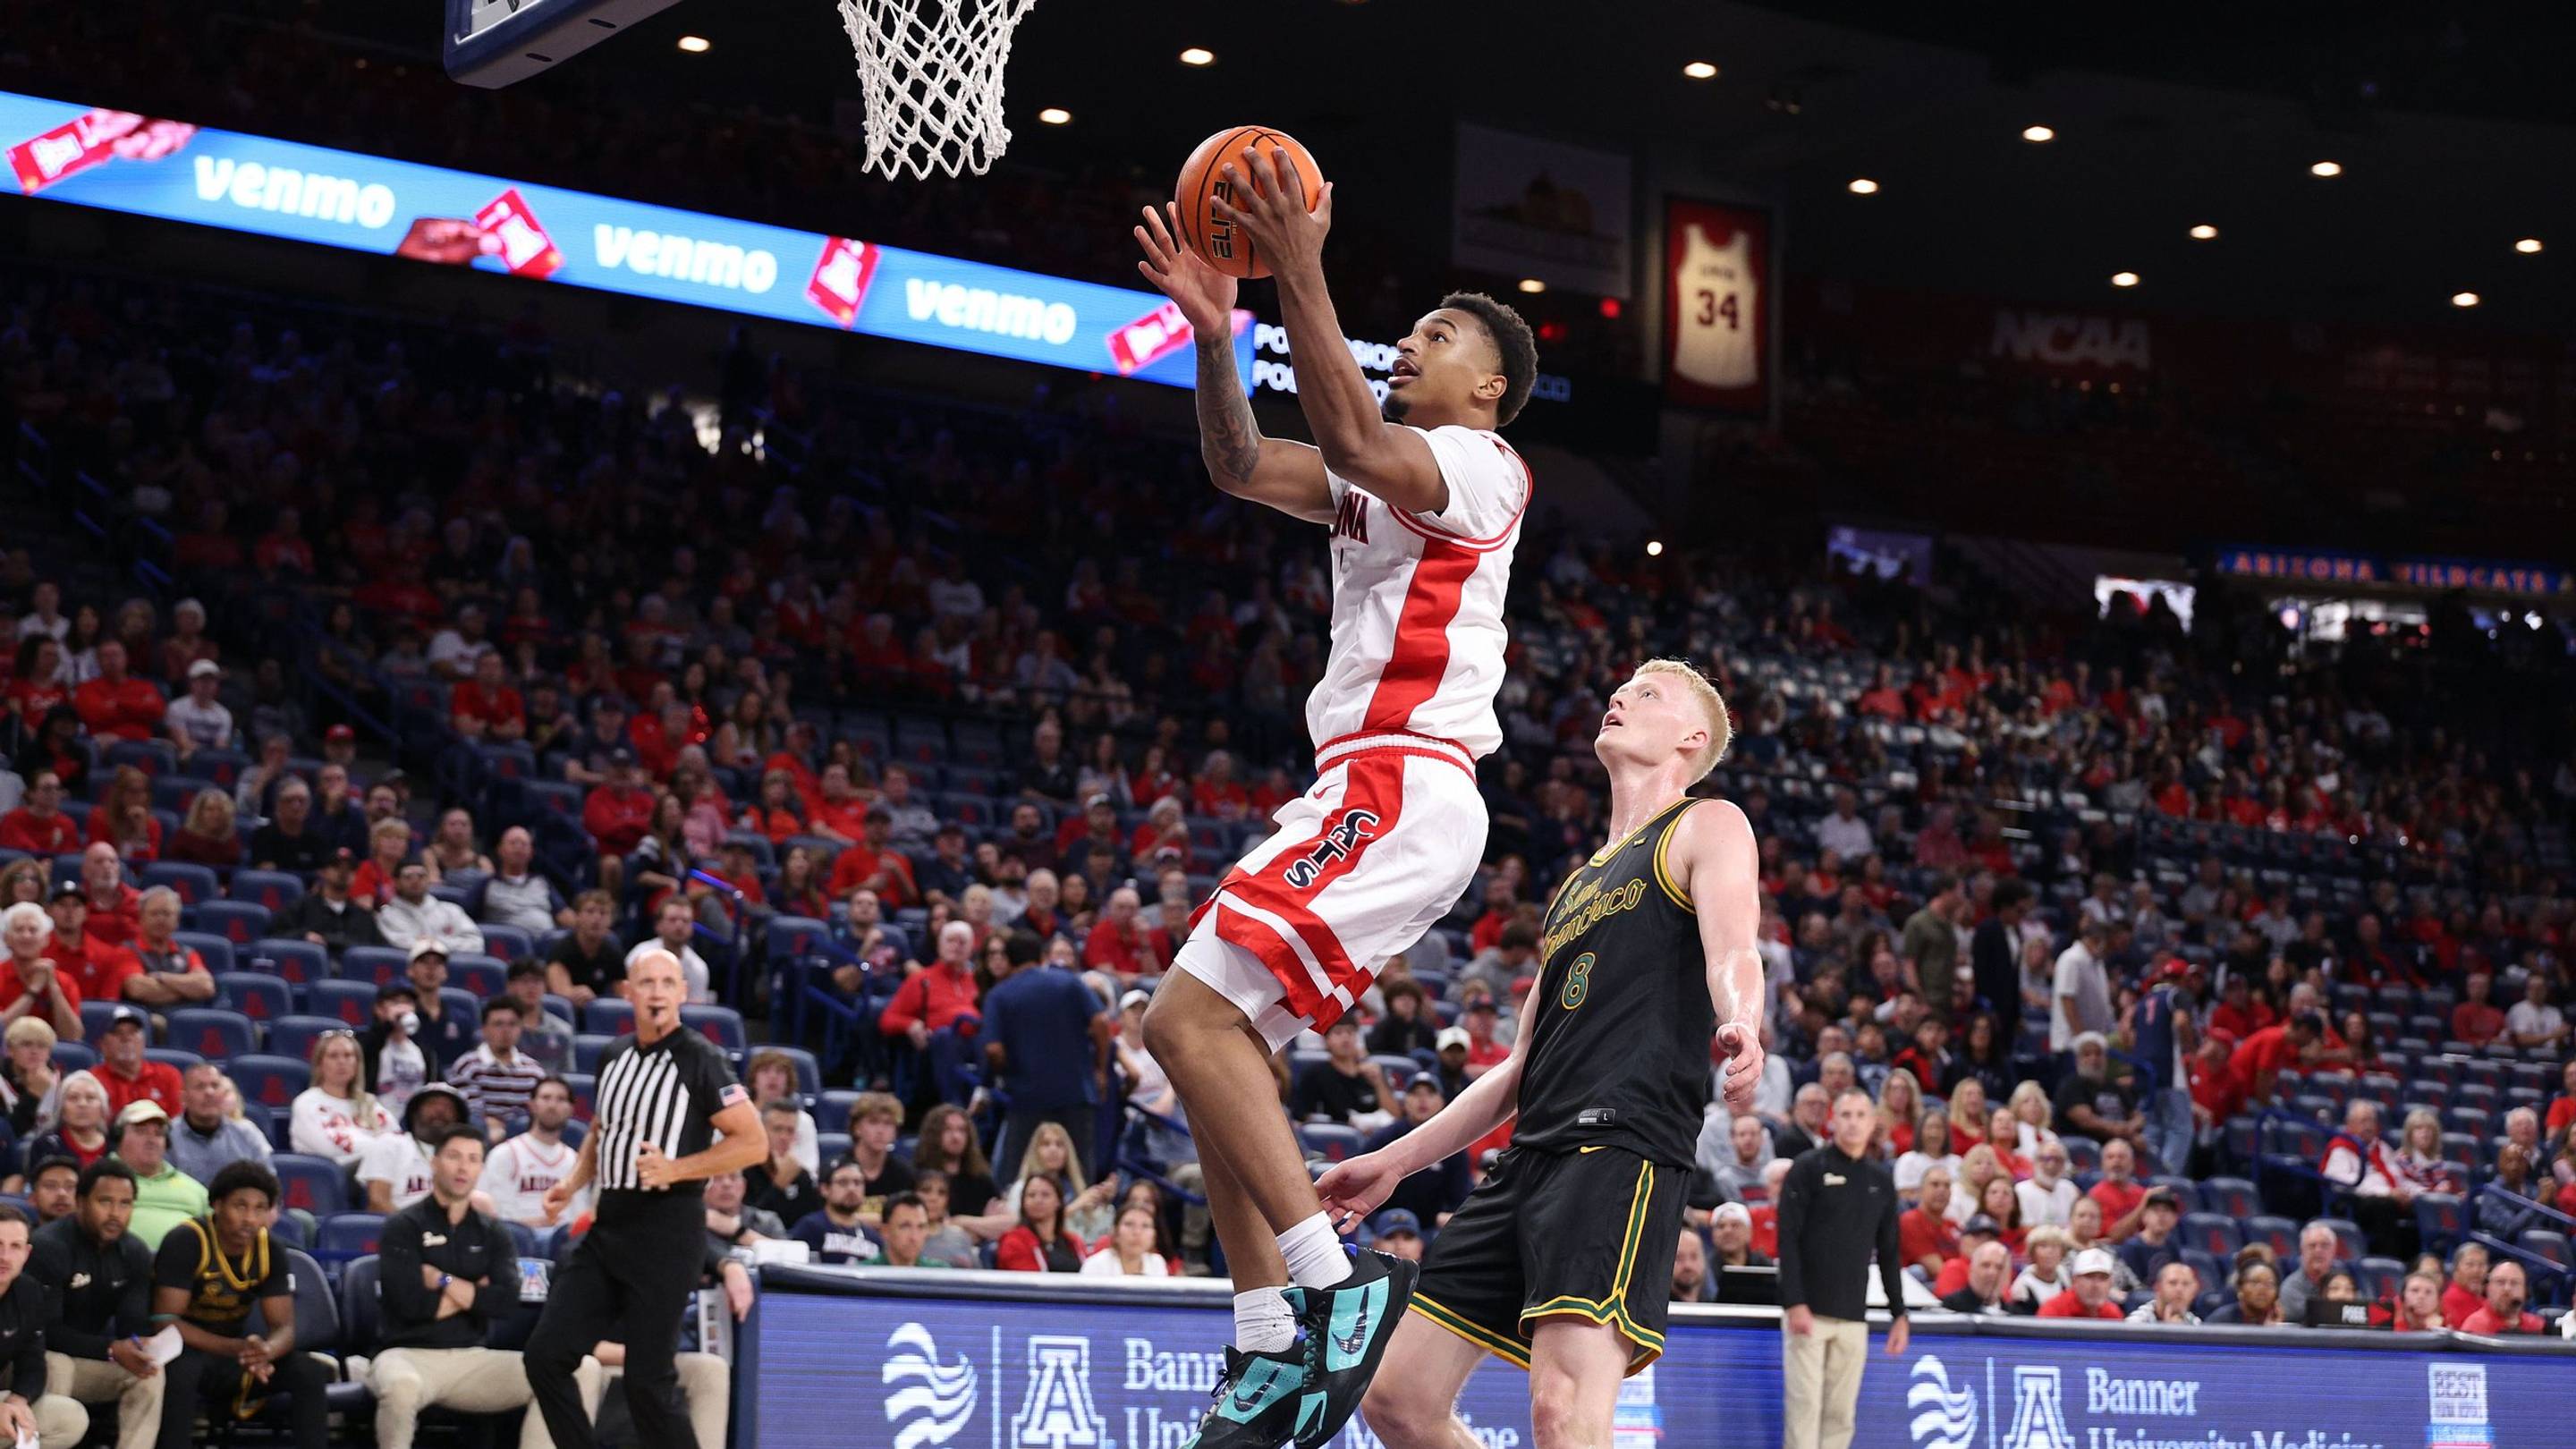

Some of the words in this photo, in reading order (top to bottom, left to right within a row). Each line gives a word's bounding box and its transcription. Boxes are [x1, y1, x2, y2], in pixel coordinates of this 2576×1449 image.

[194, 156, 395, 229] venmo
[594, 223, 777, 294] venmo
[905, 277, 1077, 345] venmo
[1697, 287, 1739, 330] 34
[1990, 308, 2151, 372] NCAA
[2233, 551, 2376, 583] ARIZONA
[2390, 562, 2546, 594] WILDCATS
[1556, 877, 1602, 922] San
[1562, 952, 1596, 1010] 8
[1603, 1112, 1608, 1122] L
[1123, 1337, 1224, 1392] Bann
[2433, 1369, 2483, 1399] BEST
[2085, 1367, 2201, 1416] Banner
